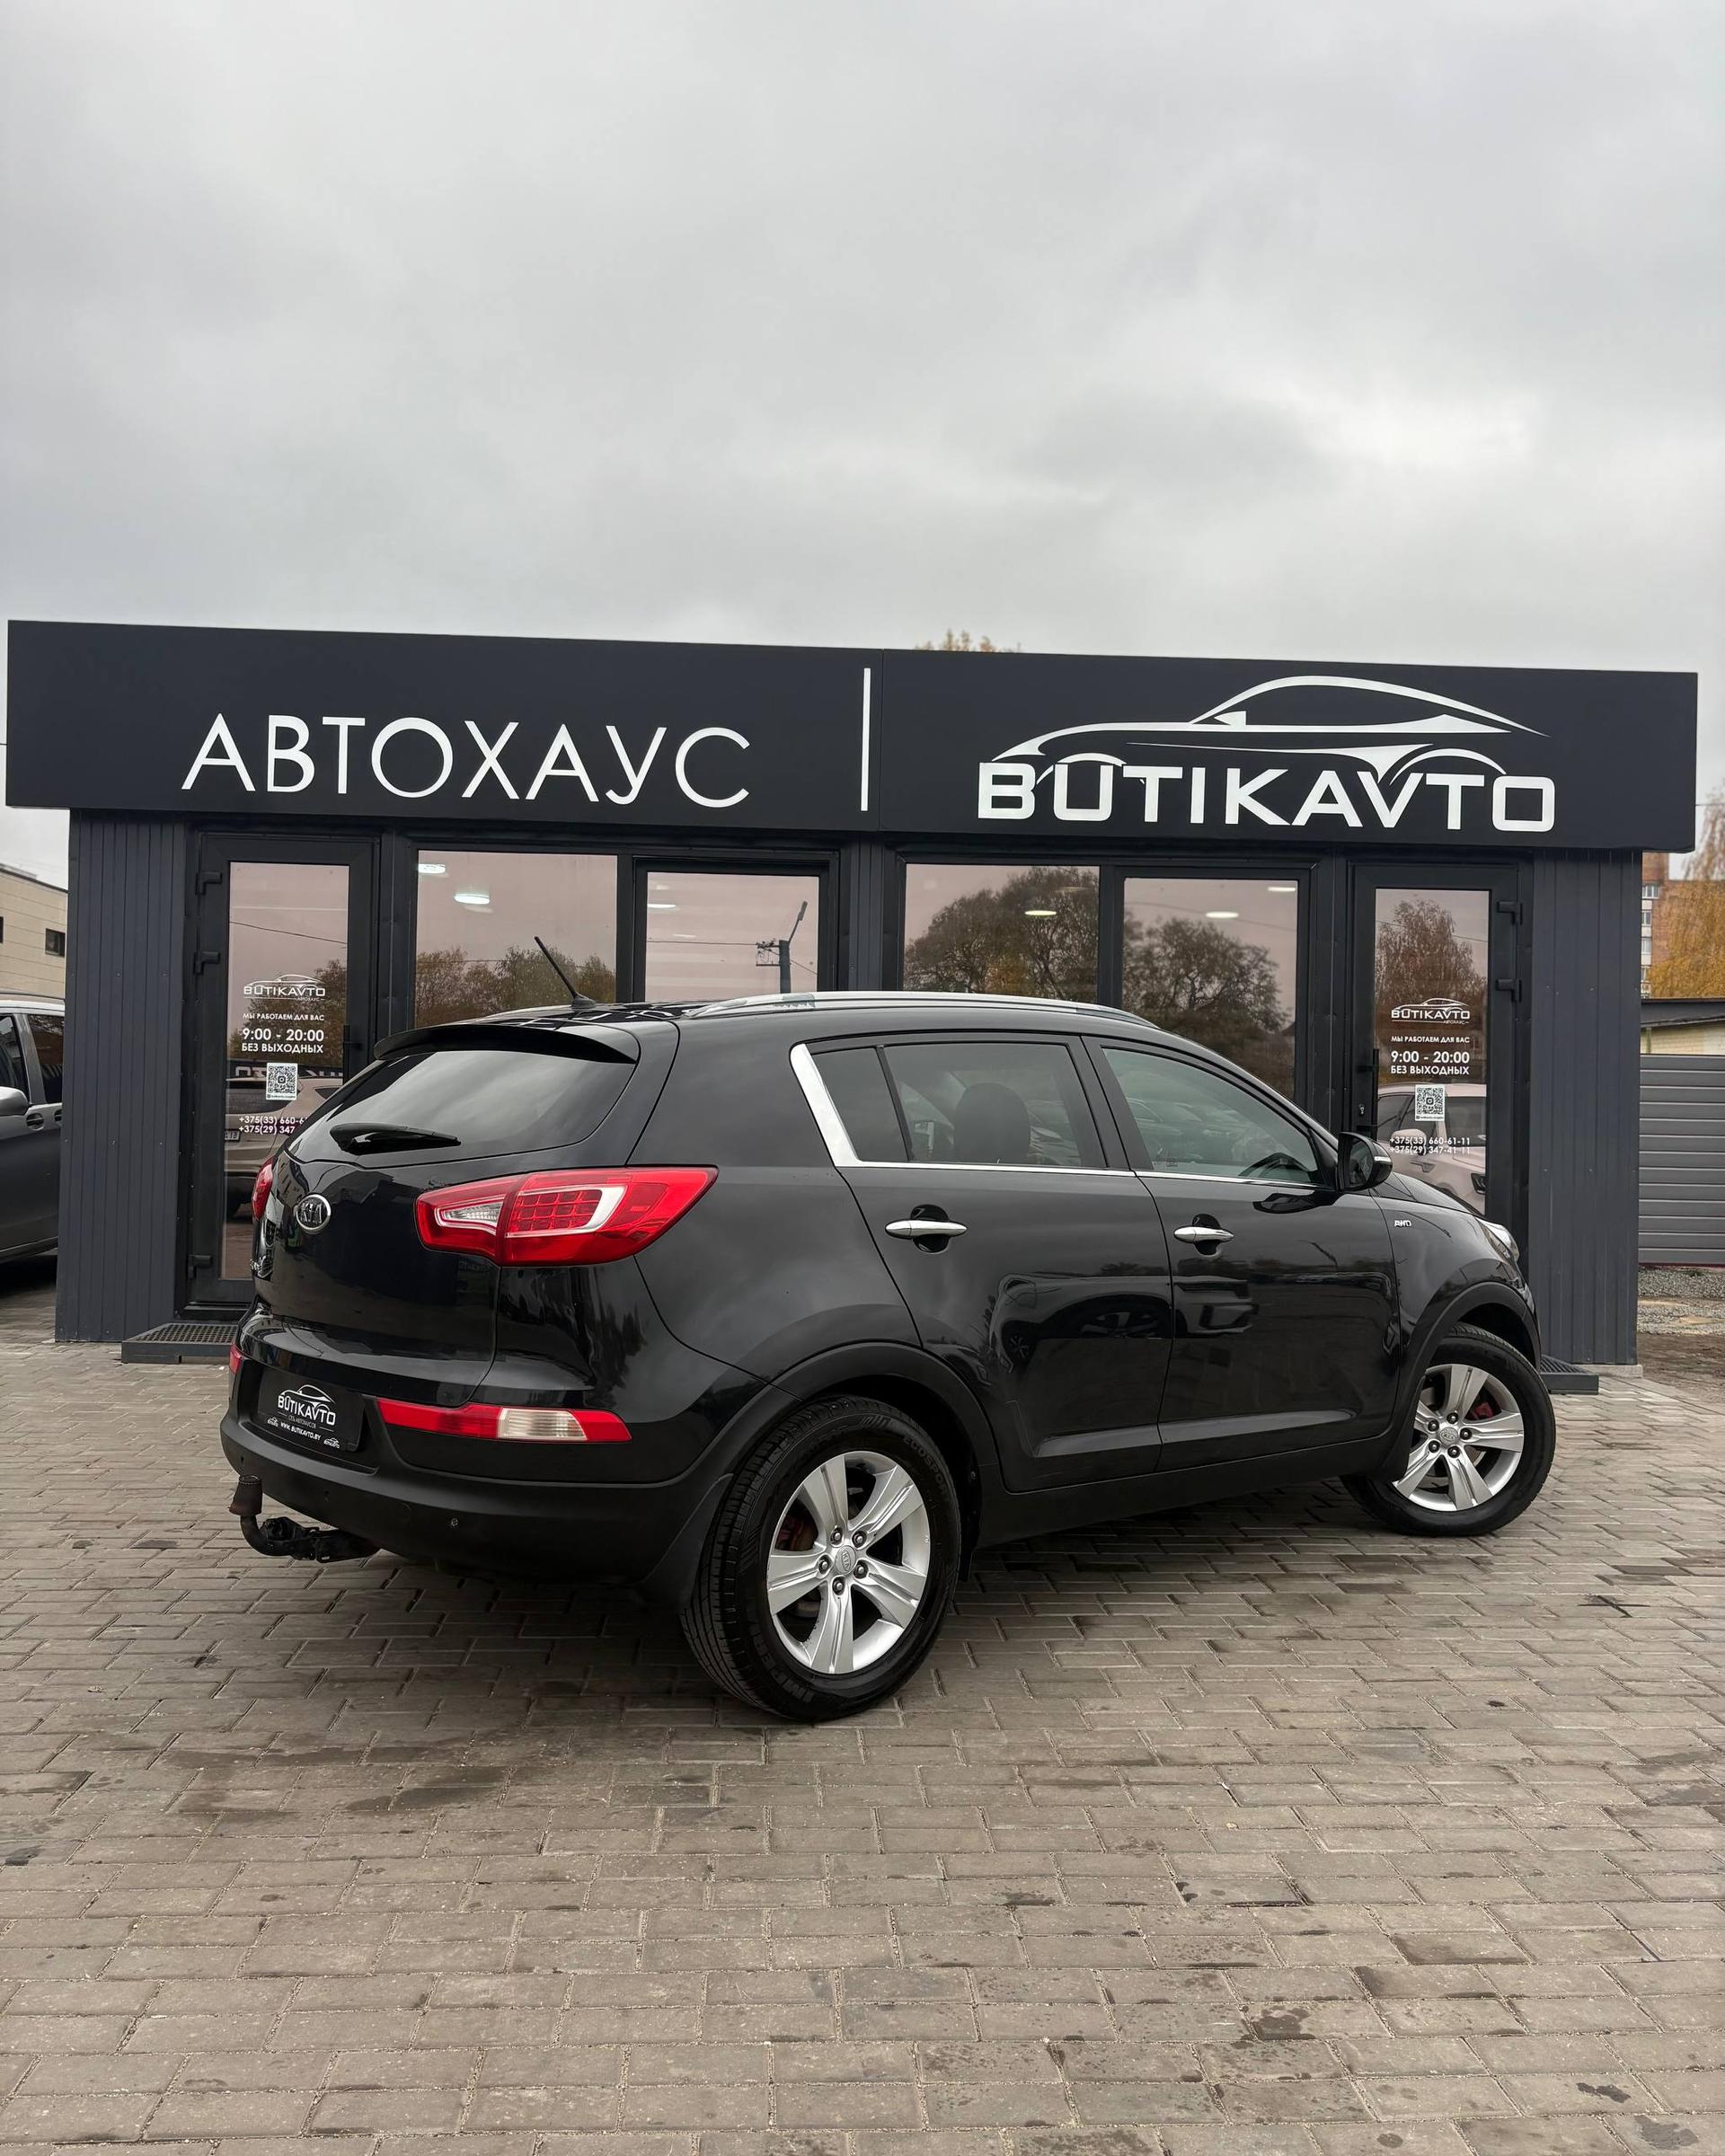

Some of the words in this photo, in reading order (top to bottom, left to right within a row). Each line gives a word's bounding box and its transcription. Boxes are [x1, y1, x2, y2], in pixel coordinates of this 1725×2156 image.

[181, 713, 751, 808] АВТОХАУС
[978, 762, 1555, 833] BUTIKAVTO
[243, 985, 325, 997] BUTIKAVTO
[256, 1012, 293, 1021] РАБОТАЕМ
[294, 1013, 309, 1021] ДЛЯ
[310, 1013, 325, 1021] ВАС
[1391, 1009, 1471, 1020] BUTIKAVTO
[243, 1028, 271, 1040] 9:00
[286, 1029, 324, 1042] 20:00
[242, 1042, 259, 1052] БЕЗ
[261, 1043, 324, 1054] ВЫХОДНЫХ
[1391, 1050, 1420, 1064] 9:00
[1433, 1050, 1470, 1064] 20:00
[1391, 1065, 1407, 1074] БЕЗ
[1410, 1065, 1470, 1075] ВЫХОДНЫХ
[239, 1115, 278, 1126] +375(33)
[238, 1125, 278, 1135] +375(29)
[1389, 1136, 1427, 1146] +375(33)
[1429, 1136, 1470, 1145] 660-61-11
[1390, 1145, 1427, 1155] +375(29)
[1393, 1219, 1412, 1227] AWD
[278, 1395, 336, 1426] BUTIKAVTO
